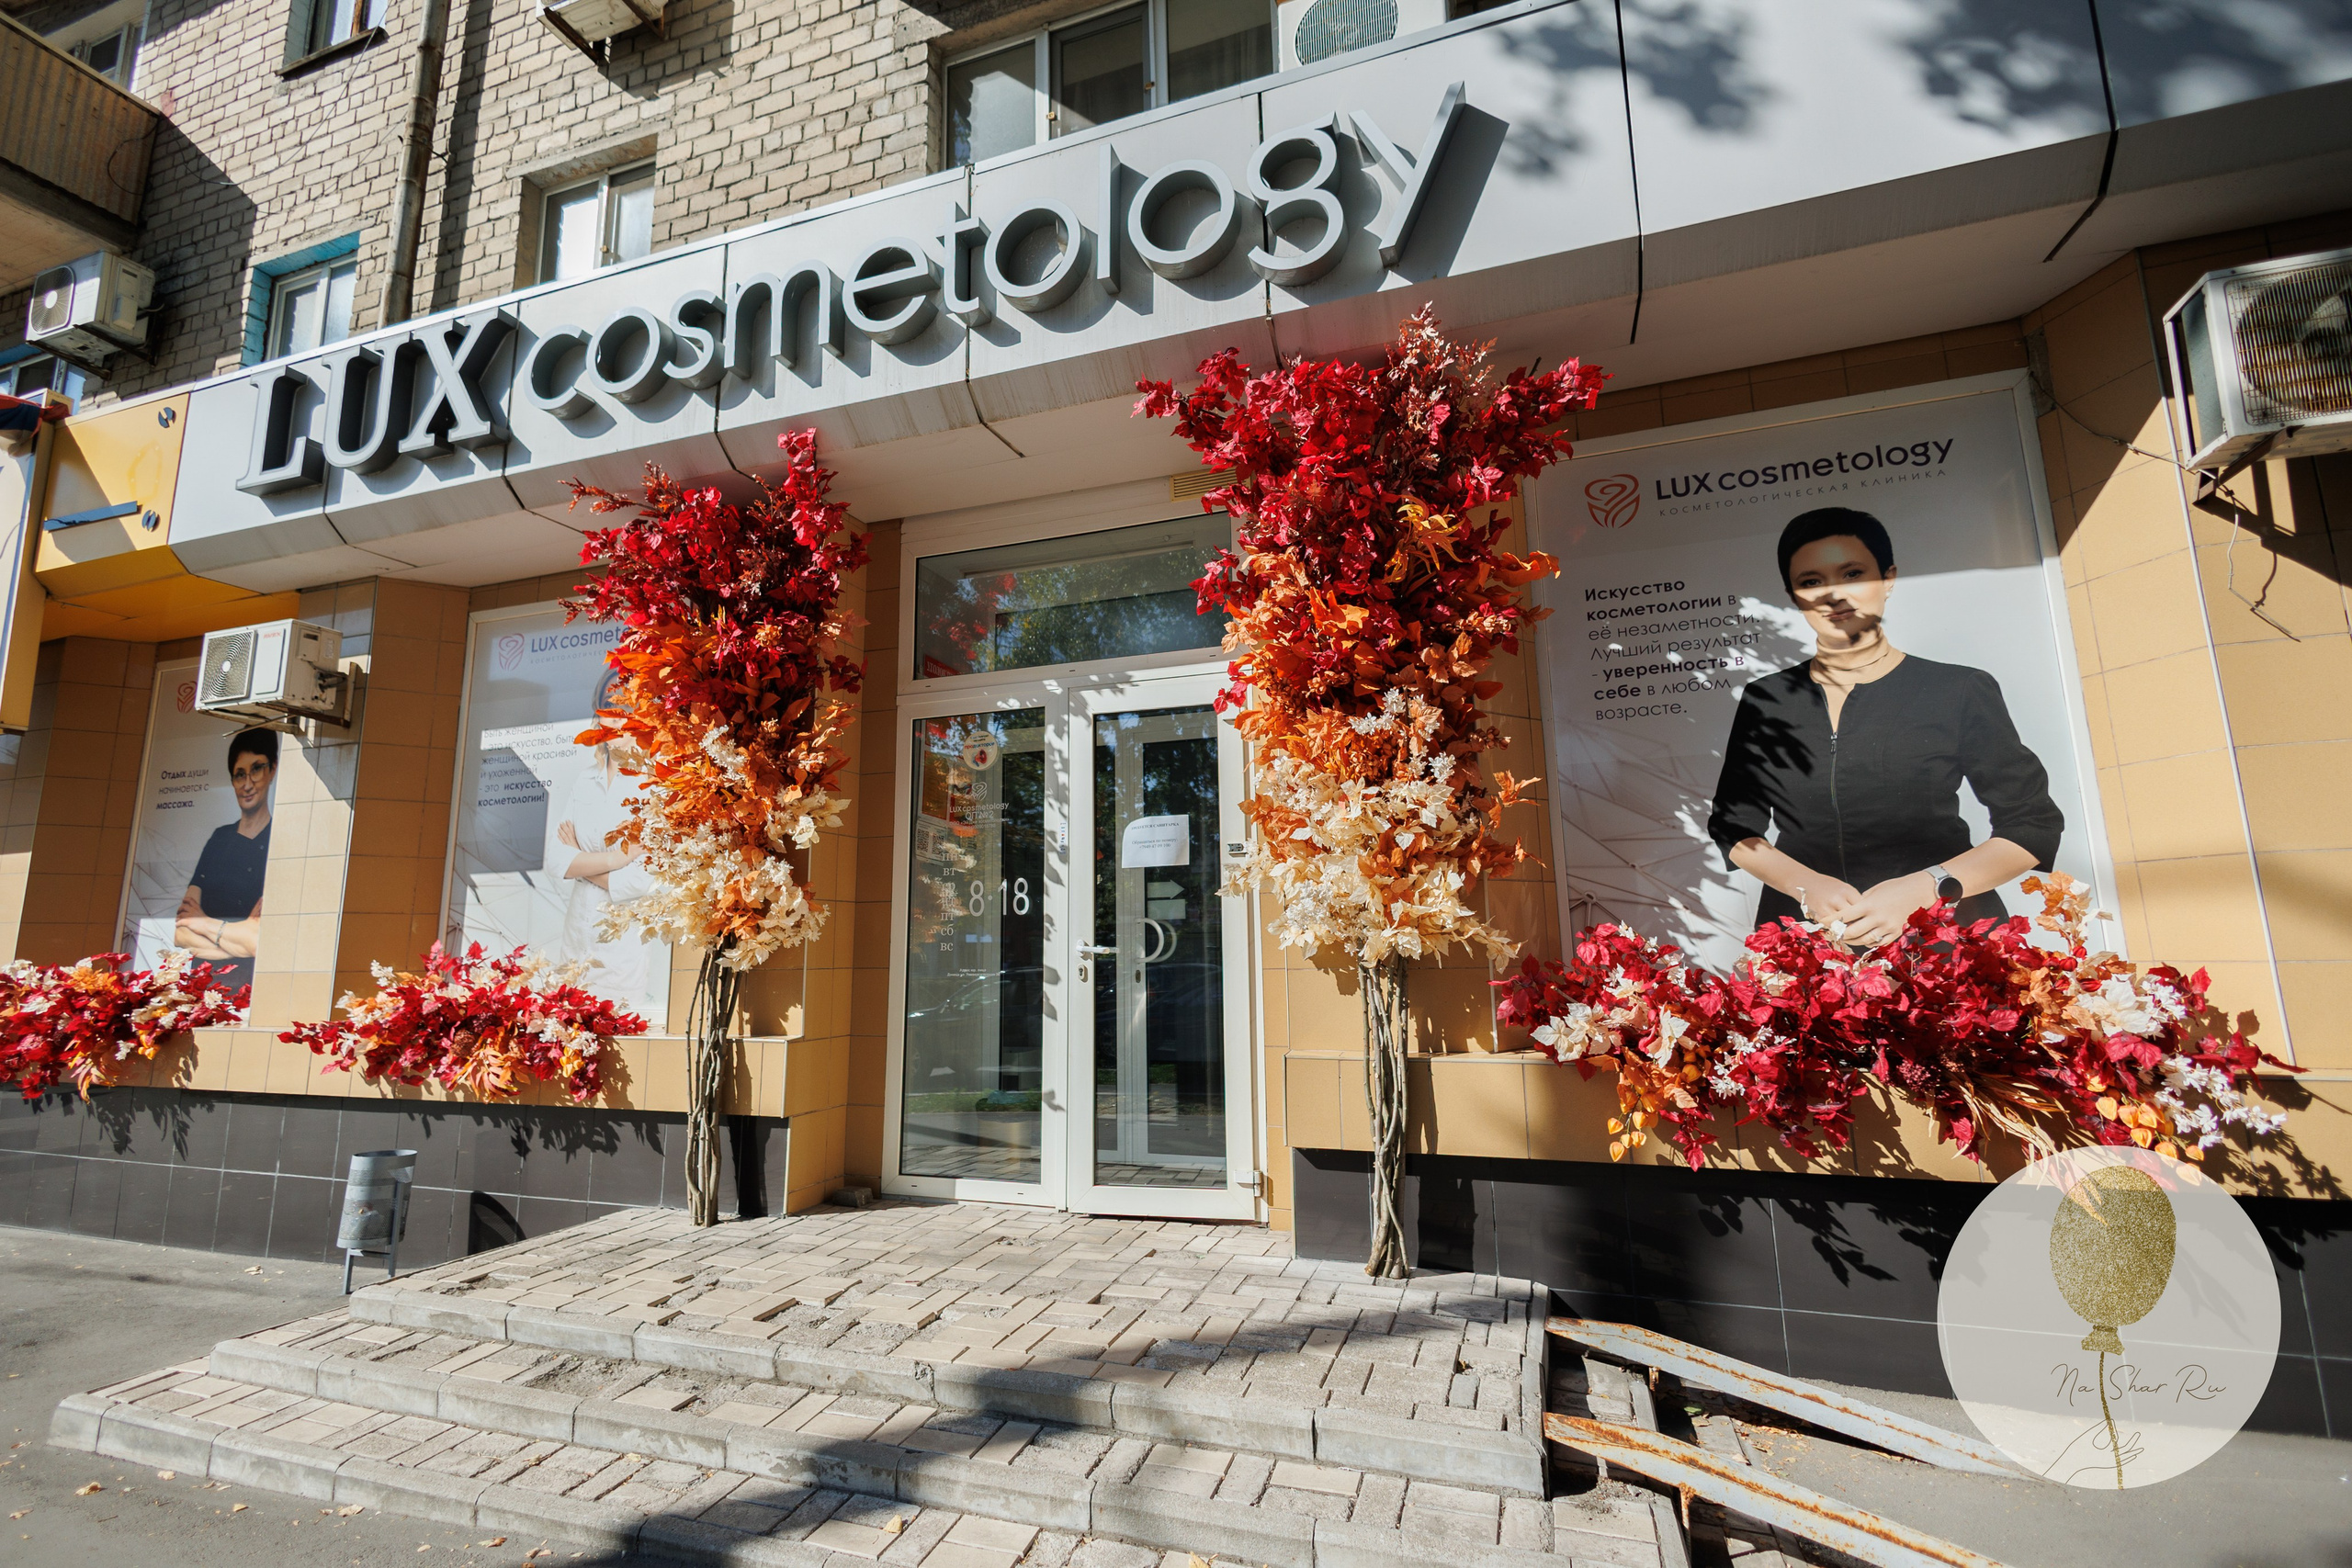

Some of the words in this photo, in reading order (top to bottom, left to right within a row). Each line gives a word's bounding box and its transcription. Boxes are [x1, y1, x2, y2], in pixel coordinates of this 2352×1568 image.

[236, 307, 508, 491] LUX
[523, 81, 1466, 420] cosmetology
[1655, 472, 1713, 501] LUX
[1718, 438, 1954, 491] cosmetology
[1659, 483, 1849, 516] КОСМЕТОЛОГИЧЕСКАЯ
[1860, 469, 1946, 488] КЛИНИКА
[1585, 581, 1685, 602] Искусство
[1587, 598, 1722, 622] косметологии
[1727, 594, 1736, 605] в
[1589, 626, 1611, 640] её
[1617, 614, 1760, 637] незаметности.
[531, 635, 558, 653] LUX
[560, 626, 630, 649] cosmet
[1590, 640, 1662, 662] Лучший
[1668, 632, 1761, 654] результат
[1602, 657, 1728, 682] уверенность
[1735, 656, 1745, 666] в
[1594, 684, 1641, 701] себе
[1647, 685, 1656, 696] в
[1661, 677, 1732, 694] любом
[1595, 703, 1688, 721] возрасте.
[484, 728, 503, 739] Быть
[504, 722, 554, 736] женщиной
[504, 737, 553, 750] искусство,
[481, 751, 530, 765] женщиной
[533, 746, 577, 761] красивой
[161, 771, 186, 780] Отдых
[187, 769, 209, 779] души
[488, 764, 537, 780] ухоженной
[159, 784, 202, 795] начинается
[485, 784, 499, 793] это
[503, 779, 552, 792] искусство
[156, 800, 195, 809] массажа.
[478, 792, 545, 807] косметологии!
[962, 802, 1010, 813] cosmetology
[942, 852, 958, 862] пн
[943, 867, 956, 876] вт
[940, 912, 955, 921] пт
[940, 924, 955, 936] сб
[940, 942, 954, 952] вс
